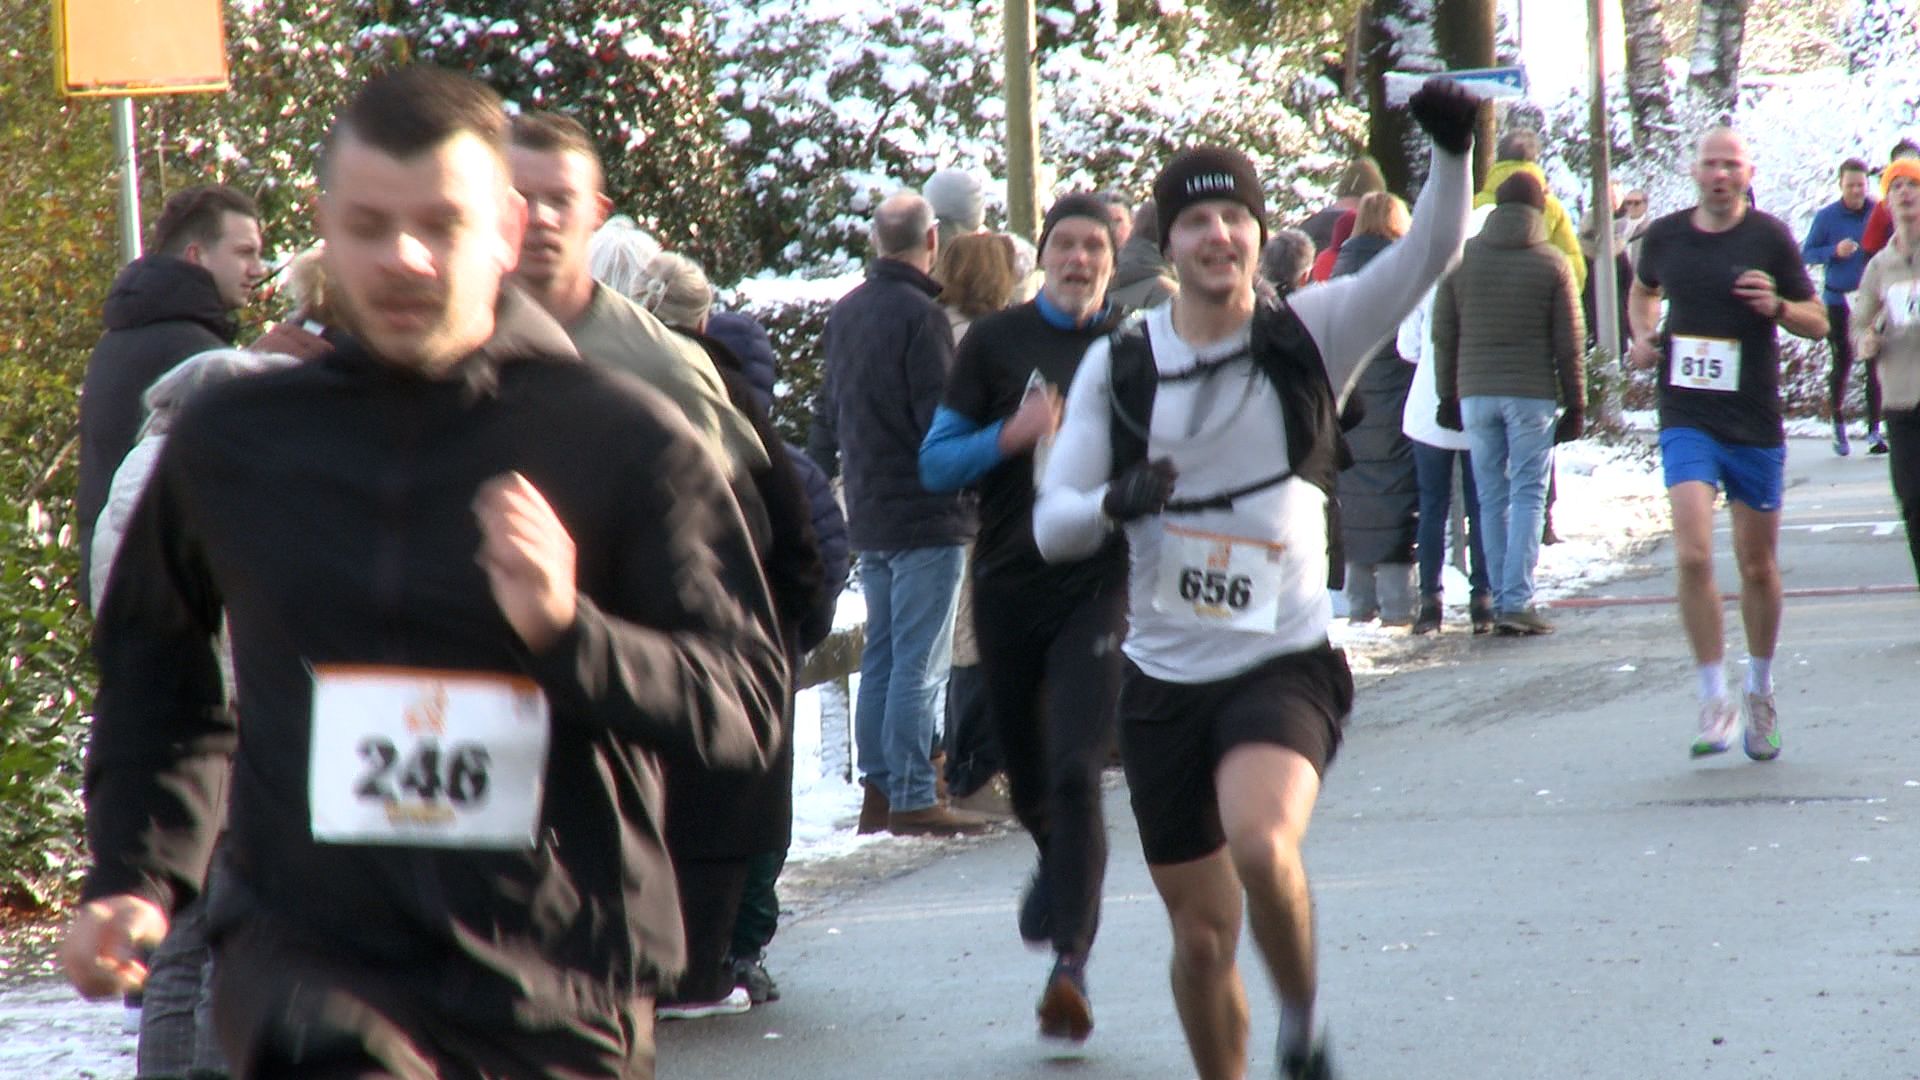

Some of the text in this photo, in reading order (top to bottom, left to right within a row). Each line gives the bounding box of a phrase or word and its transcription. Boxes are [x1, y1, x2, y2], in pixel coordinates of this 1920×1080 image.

[1681, 356, 1723, 379] 815
[1180, 568, 1252, 610] 656
[354, 735, 490, 809] 246
